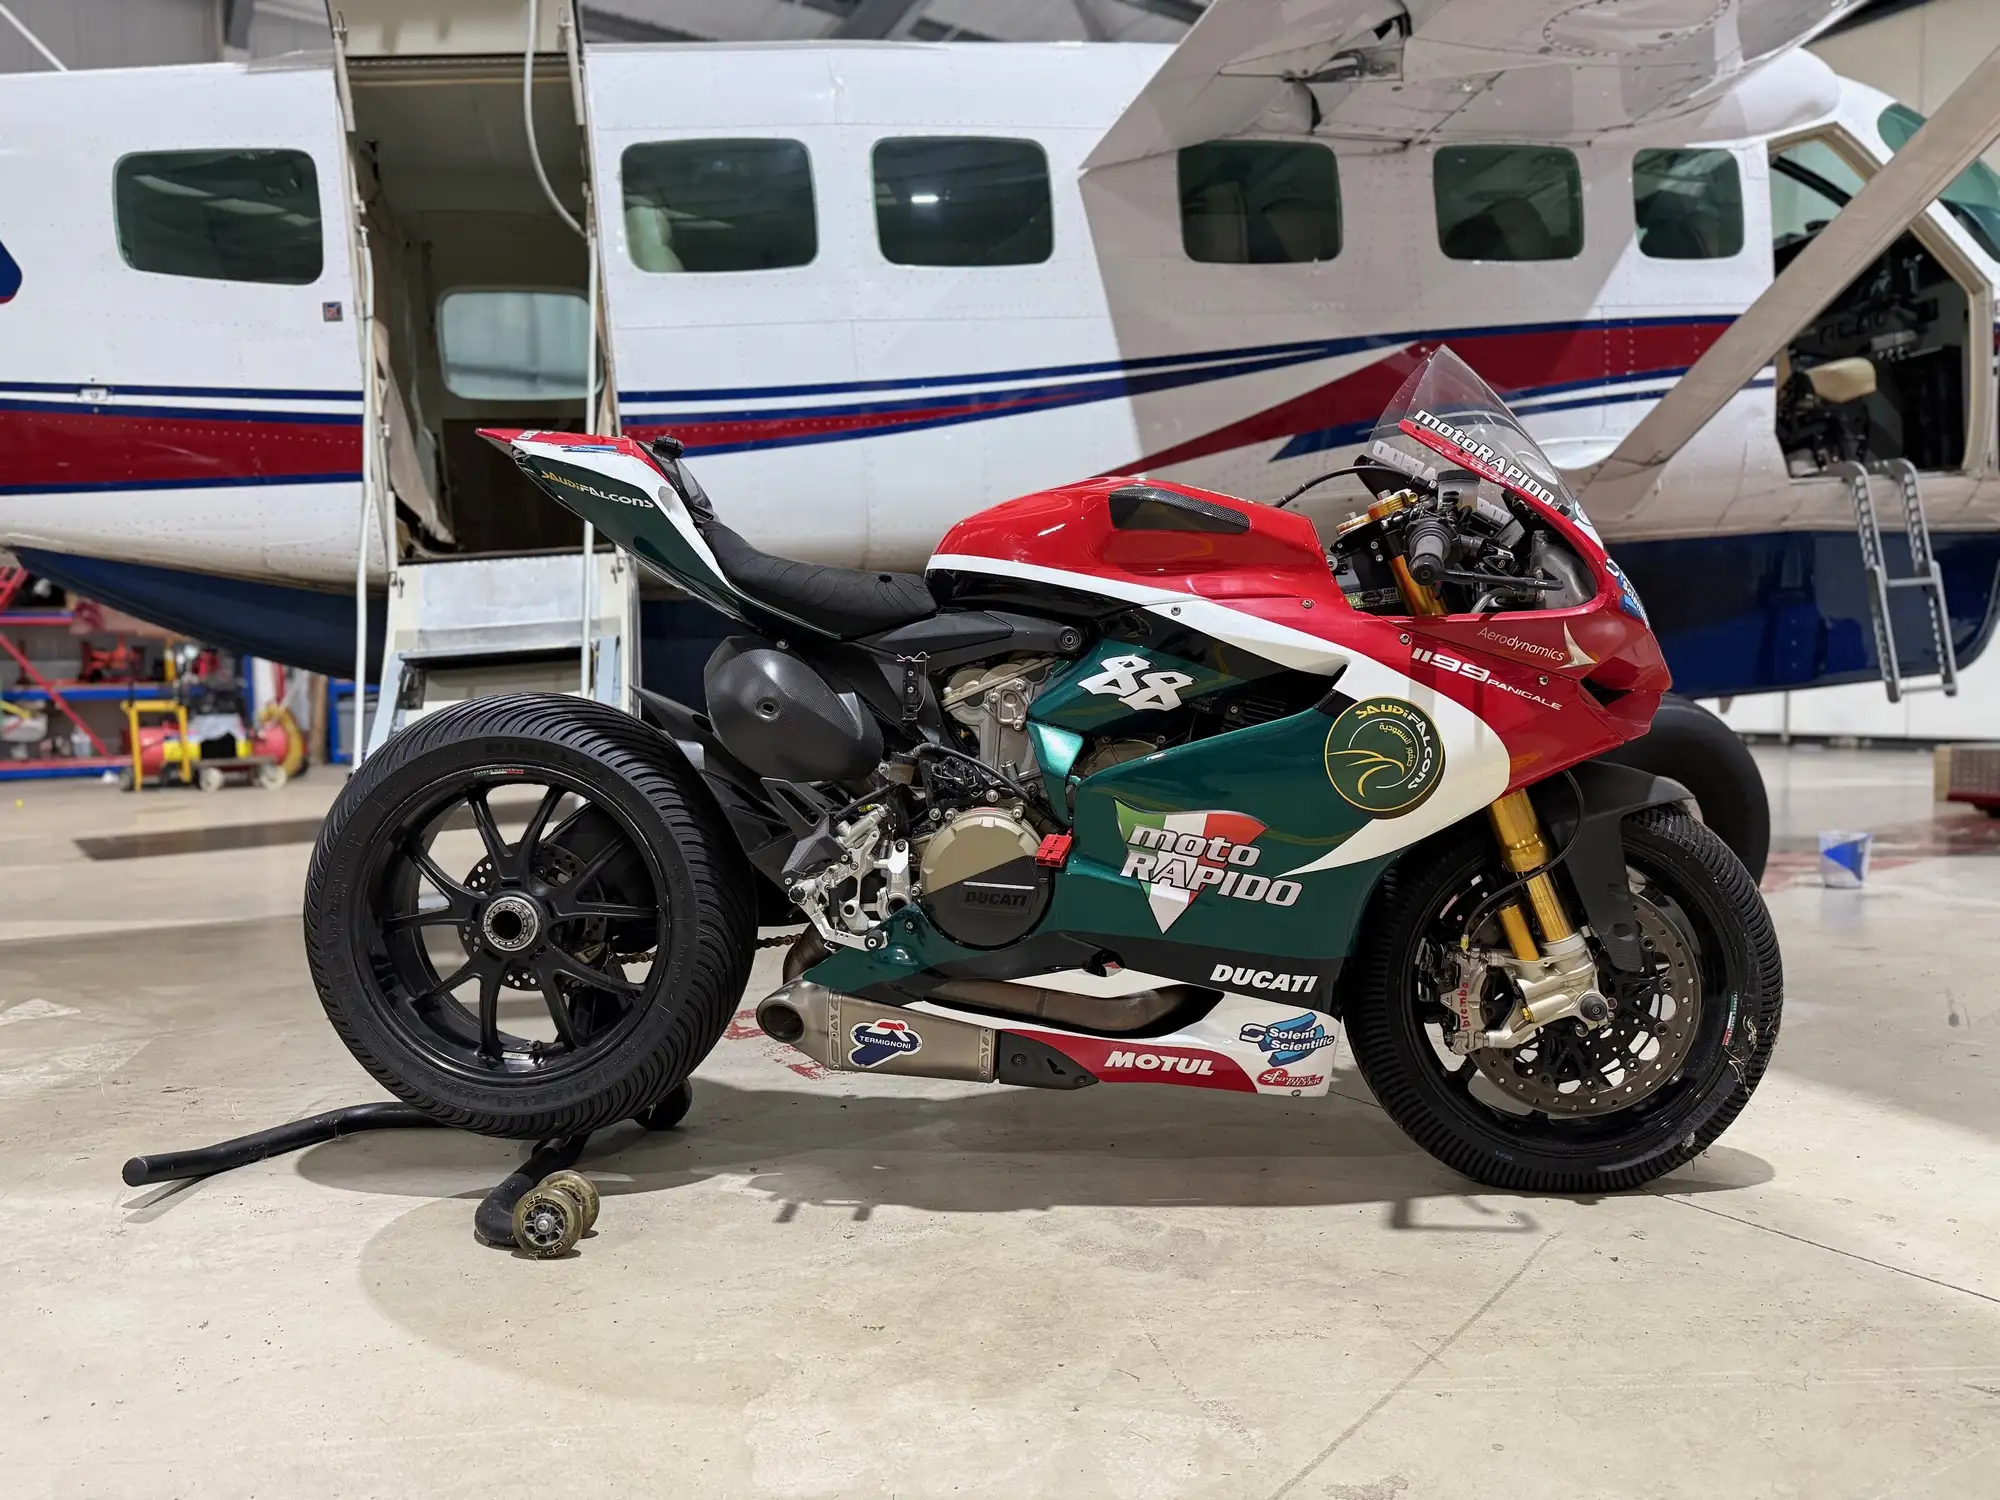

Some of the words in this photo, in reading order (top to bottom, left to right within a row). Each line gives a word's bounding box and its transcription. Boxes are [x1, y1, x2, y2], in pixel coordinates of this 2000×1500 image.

[1413, 409, 1556, 506] motoRAPIDO
[1476, 626, 1566, 662] Aerodynamics
[1077, 654, 1195, 712] 88
[1411, 647, 1491, 684] 1199
[1487, 678, 1563, 711] PANIGALE
[1127, 823, 1262, 868] moto
[1118, 850, 1304, 908] RAPIDO
[964, 891, 1028, 907] DUCATI
[1209, 963, 1319, 993] DUCATI
[1457, 982, 1471, 1028] brembo
[859, 1035, 912, 1050] TERMIGNONI
[1268, 1027, 1316, 1040] Solent
[1270, 1034, 1335, 1052] Scientific
[1103, 1050, 1215, 1076] MOTUL
